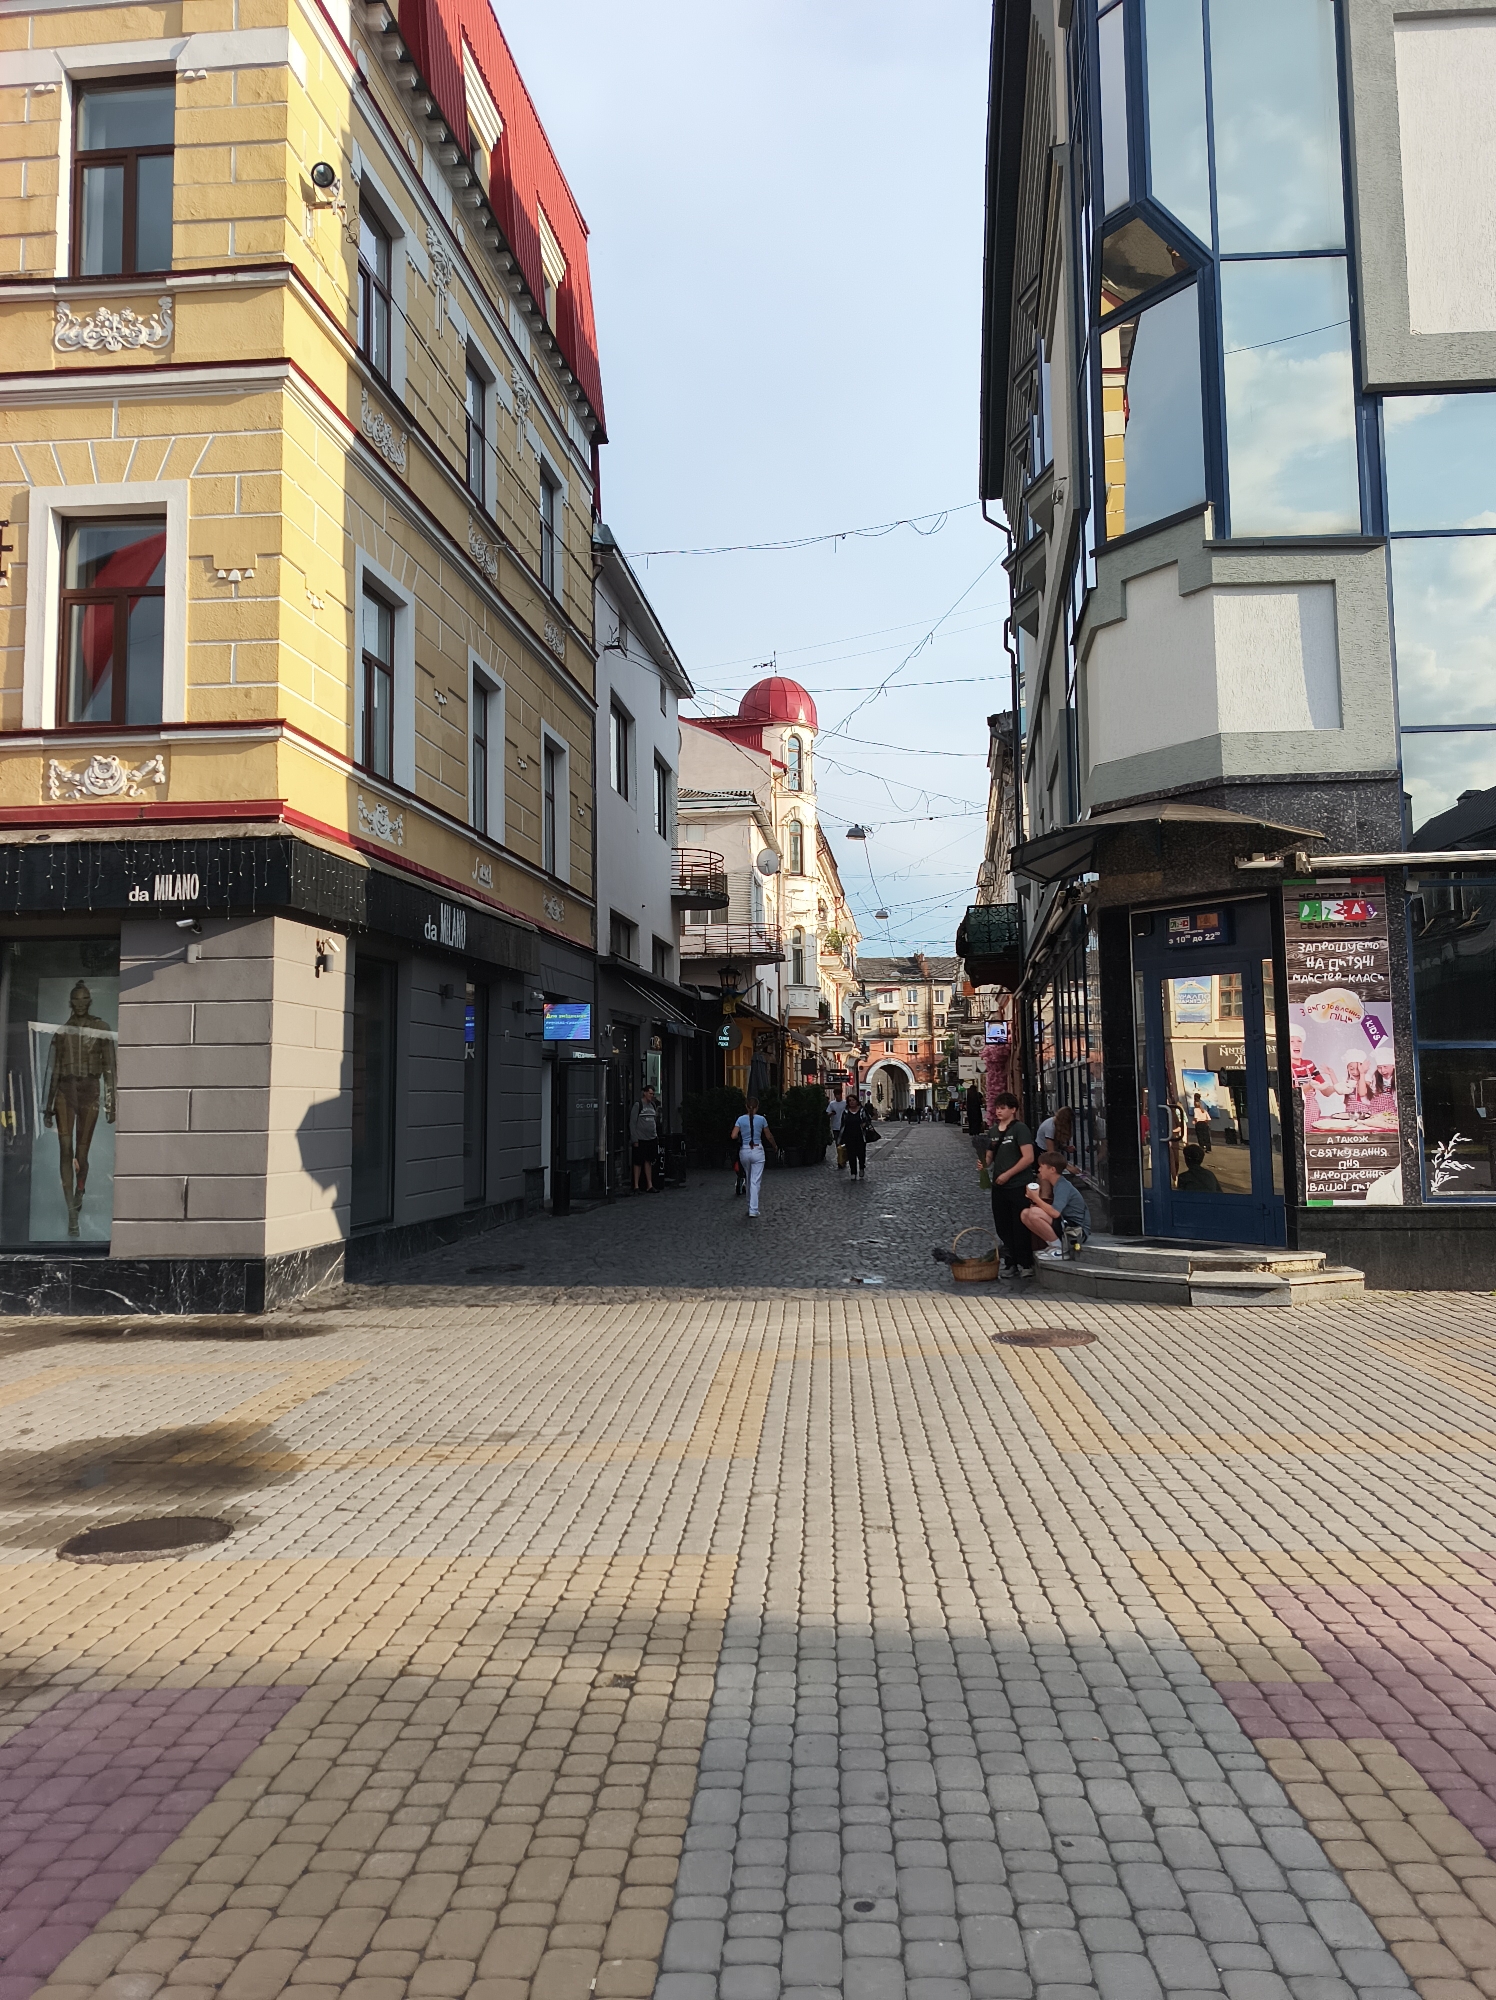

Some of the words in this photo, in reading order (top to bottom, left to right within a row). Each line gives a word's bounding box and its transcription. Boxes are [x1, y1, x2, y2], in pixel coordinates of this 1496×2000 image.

[129, 885, 149, 901] da
[154, 873, 199, 901] MILANO
[424, 914, 438, 941] da
[440, 902, 466, 950] MILANO
[1192, 935, 1203, 943] до
[1297, 941, 1380, 954] ЗАПРОШУЄМО
[1305, 955, 1325, 970] НА
[1328, 954, 1375, 971] ДИТЯЧІ
[1292, 972, 1385, 984] МАЙСТЕР-КЛАСИ
[1365, 1020, 1381, 1041] KID'S
[1326, 1136, 1334, 1144] А
[1335, 1135, 1369, 1143] ТАКОЖ
[1309, 1147, 1388, 1158] СВЯТКУВАННЯ
[1338, 1159, 1360, 1170] ДНЯ
